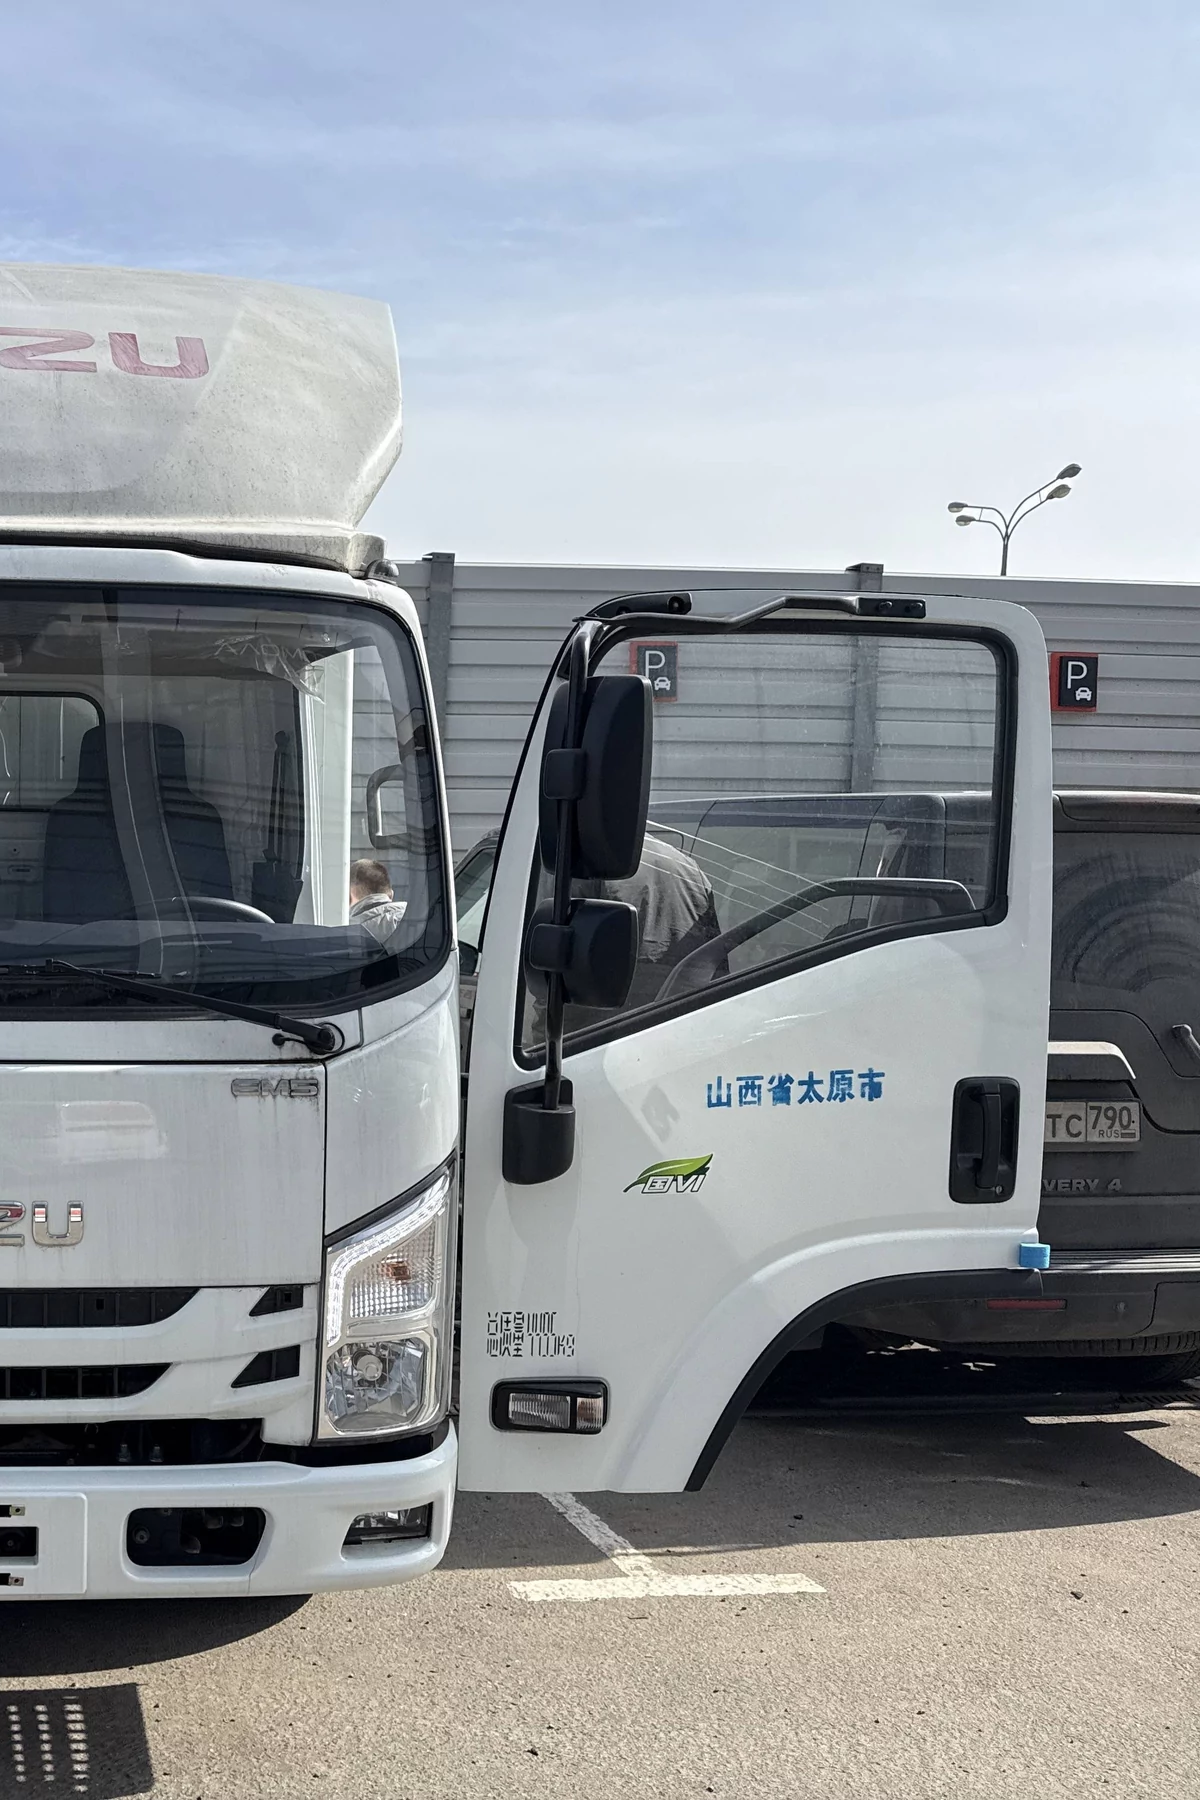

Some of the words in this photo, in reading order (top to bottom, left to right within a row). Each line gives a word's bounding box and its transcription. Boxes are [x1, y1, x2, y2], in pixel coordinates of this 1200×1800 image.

[645, 650, 666, 678] P
[1067, 661, 1088, 689] P
[706, 1067, 886, 1109] 山西省太原市
[1088, 1105, 1132, 1130] 790
[1098, 1129, 1120, 1139] RUS
[1042, 1179, 1099, 1192] VERY
[1106, 1178, 1122, 1191] 4
